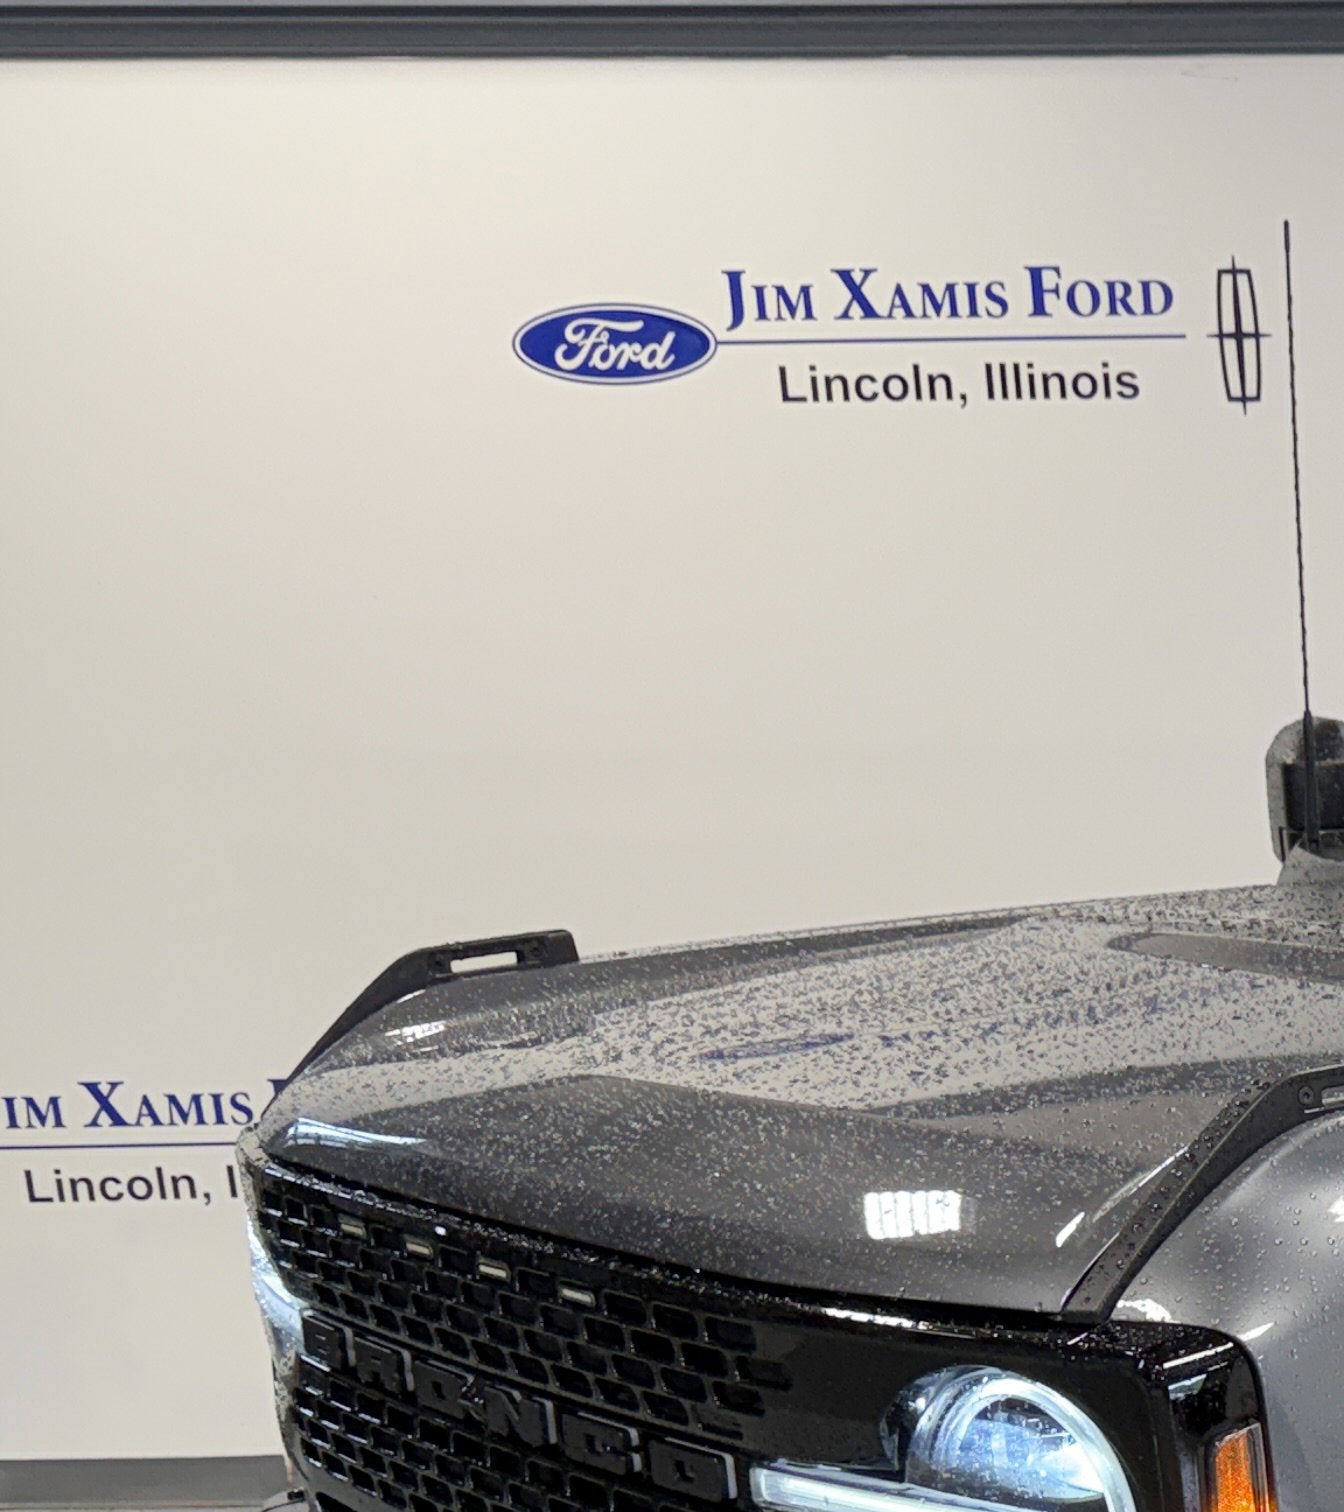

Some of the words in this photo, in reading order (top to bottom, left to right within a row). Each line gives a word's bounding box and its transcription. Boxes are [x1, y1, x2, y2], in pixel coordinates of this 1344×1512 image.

[721, 269, 817, 331] JIM
[830, 267, 1009, 320] XAMIS
[1025, 265, 1174, 318] FORD
[554, 317, 676, 372] Ford
[778, 362, 967, 408] Lincoln,
[985, 361, 1140, 402] Illinois
[2, 1096, 67, 1129] IM
[77, 1081, 254, 1128] XAMIS
[24, 1165, 212, 1206] Lincoln,
[301, 1310, 738, 1503] BRONCO
